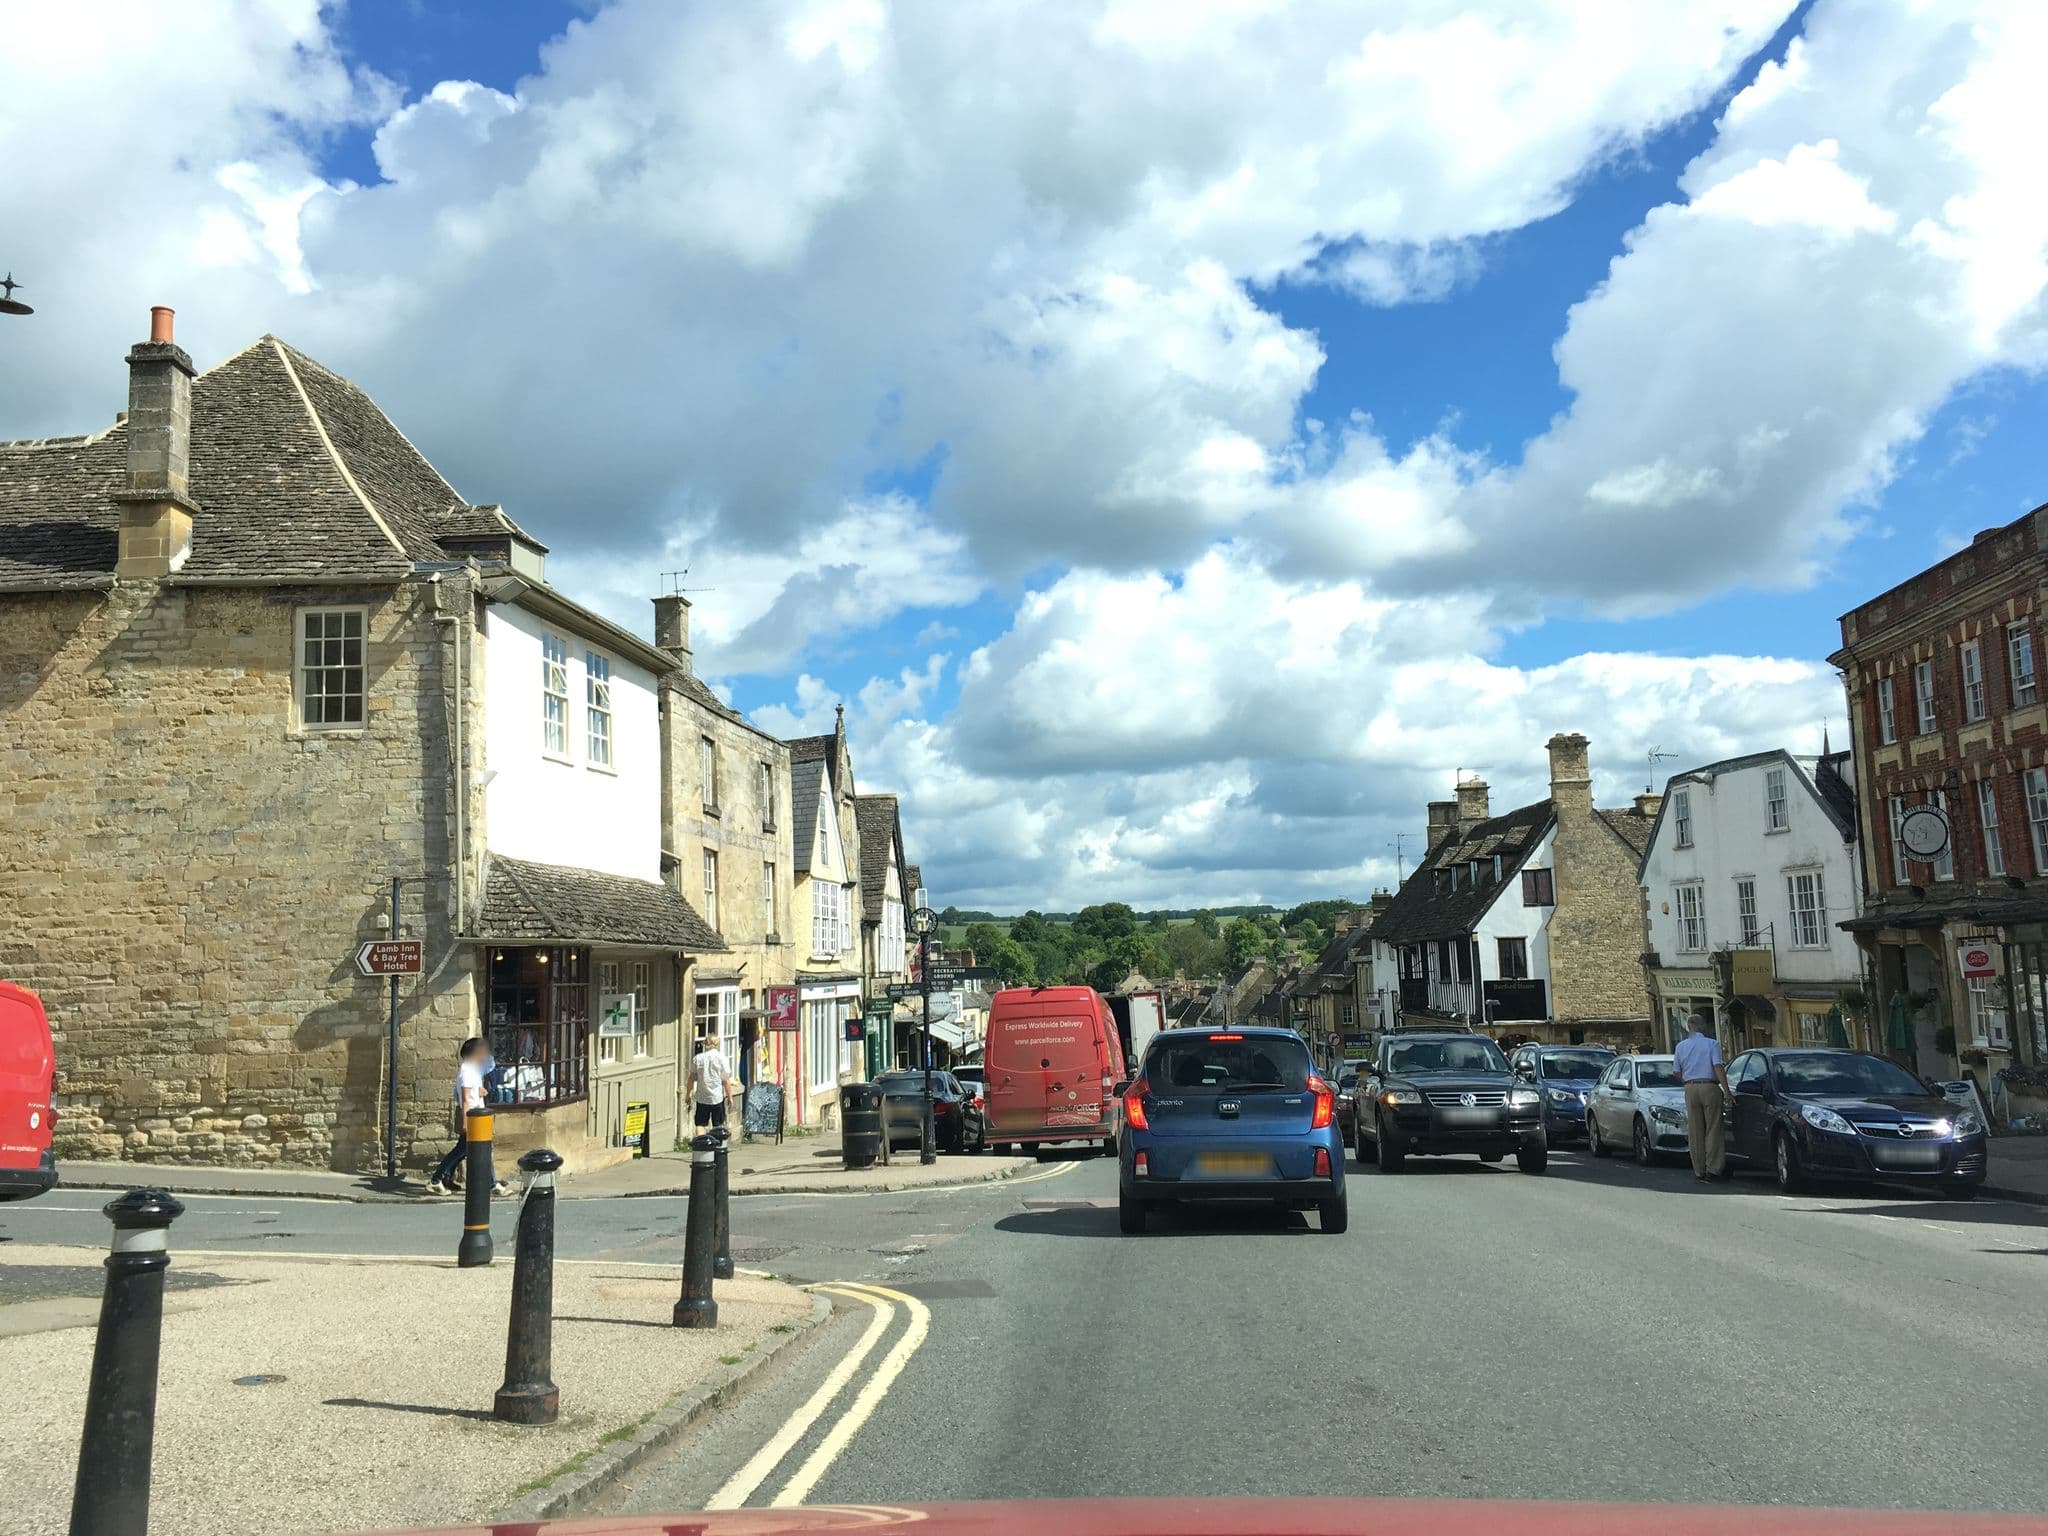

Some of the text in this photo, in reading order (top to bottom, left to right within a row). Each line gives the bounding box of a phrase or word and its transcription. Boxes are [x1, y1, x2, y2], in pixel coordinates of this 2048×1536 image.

[376, 944, 415, 953] Lamb Inn
[372, 953, 418, 962] & Bay Tree
[383, 962, 408, 970] Hotel
[1736, 967, 1769, 975] JOULES
[1005, 1020, 1083, 1031] Express Worldwide Delivery
[1014, 1036, 1075, 1046] www.parcelforce.com
